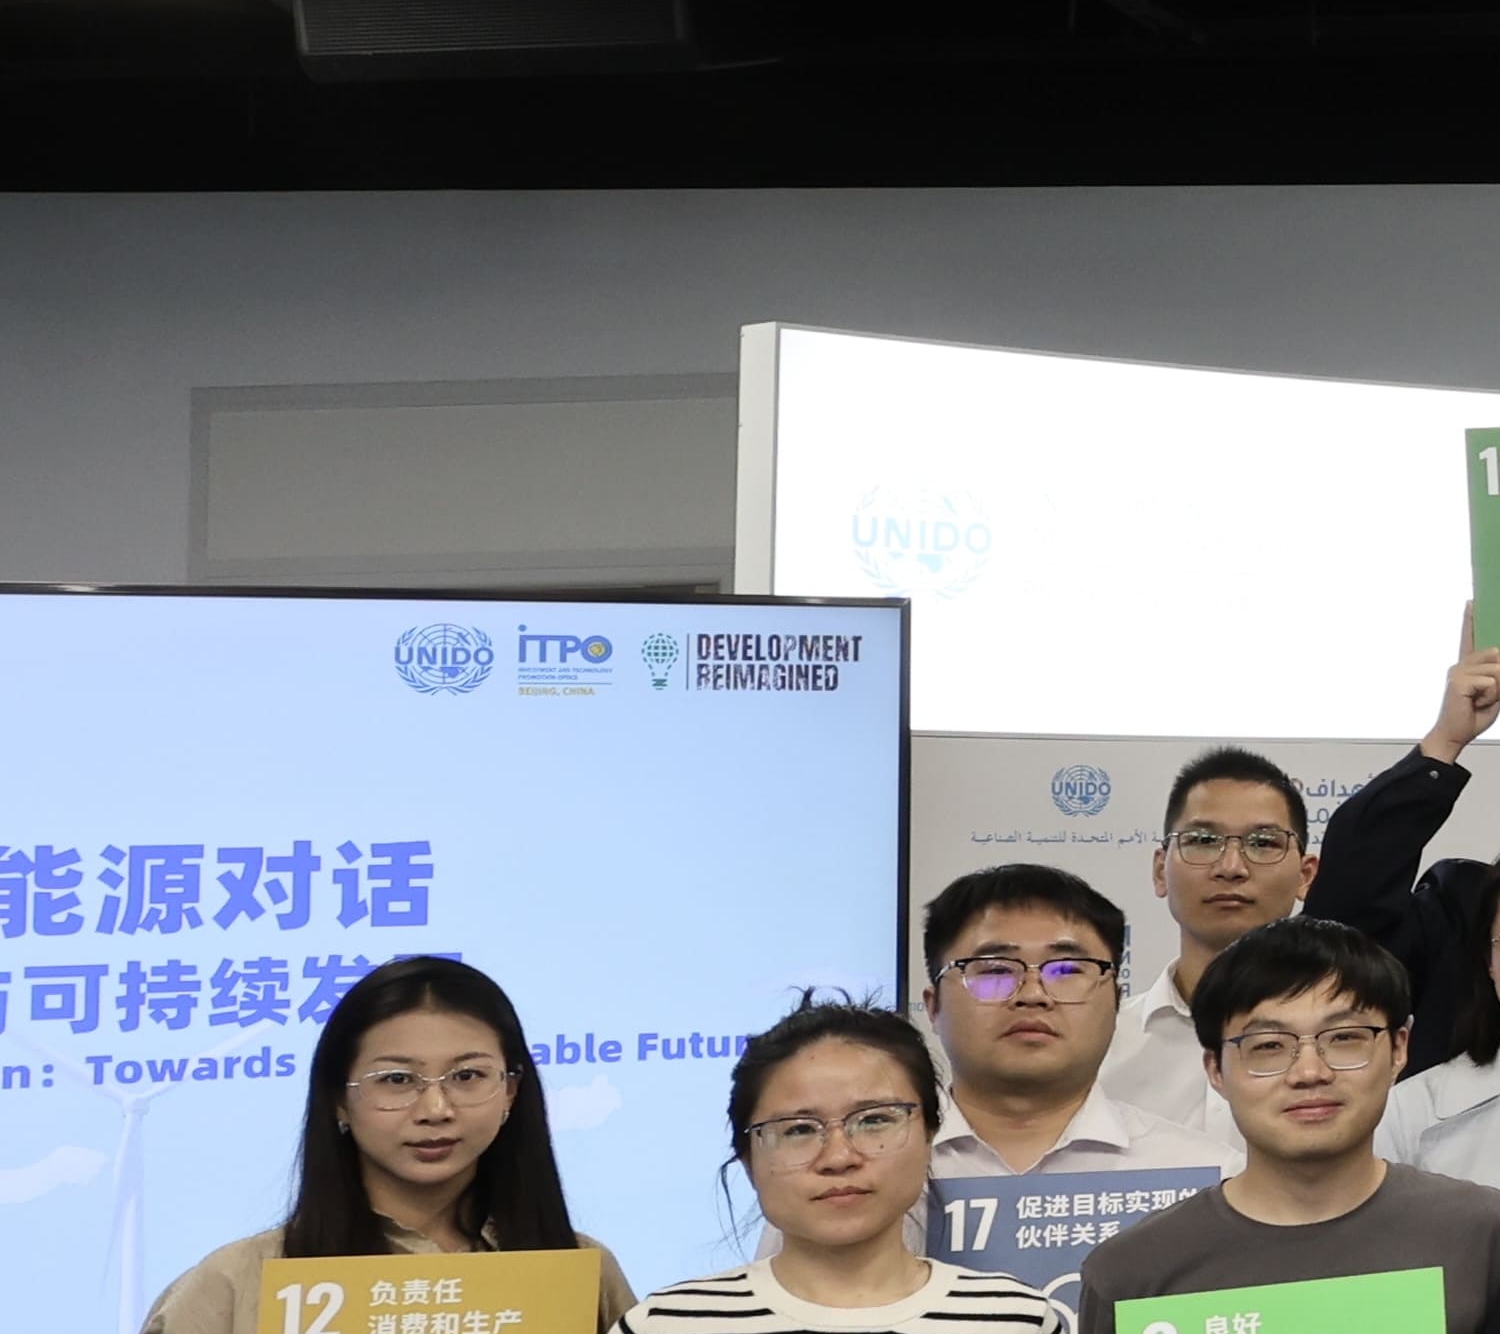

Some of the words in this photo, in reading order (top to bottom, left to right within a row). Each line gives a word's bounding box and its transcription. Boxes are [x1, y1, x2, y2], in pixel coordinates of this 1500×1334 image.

[852, 514, 992, 554] UNIDO
[395, 645, 494, 668] UNIDO
[698, 634, 862, 661] DEVELOPMENT
[697, 664, 838, 691] REIMAGINED
[1051, 781, 1111, 796] UNIDO
[0, 840, 433, 938] 能源对话
[0, 952, 462, 1034] 可持续发
[86, 1046, 295, 1085] Towards
[531, 1034, 623, 1065] able
[945, 1198, 997, 1253] 17
[1016, 1221, 1120, 1250] 伙伴关系
[370, 1279, 462, 1306] 负责任
